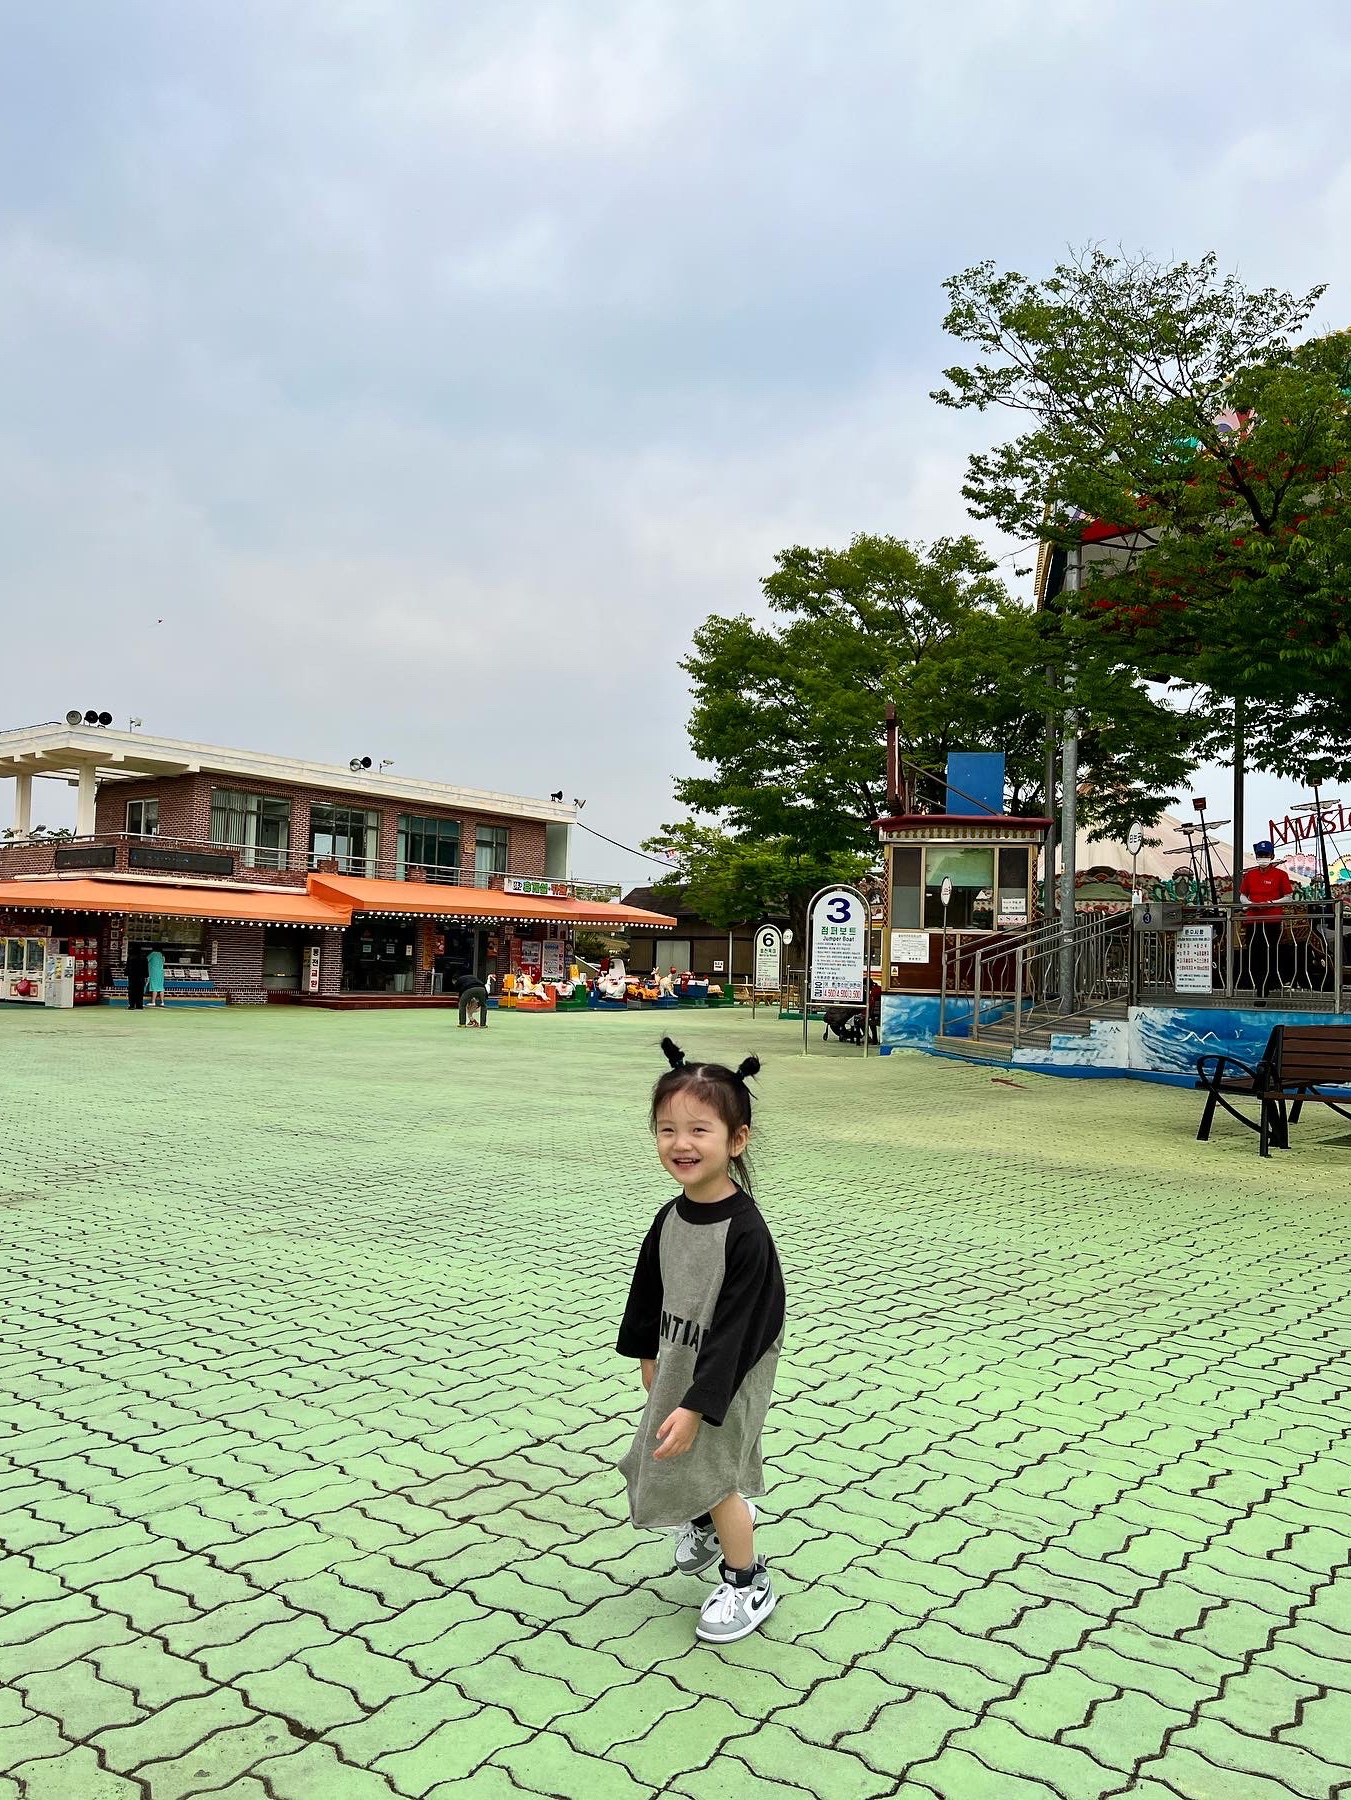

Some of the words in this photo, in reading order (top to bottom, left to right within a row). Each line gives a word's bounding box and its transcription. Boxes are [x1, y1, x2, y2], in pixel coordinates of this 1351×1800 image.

[1269, 804, 1351, 845] Musi
[826, 897, 851, 924] 3
[763, 932, 774, 947] 6
[821, 926, 856, 935] 점퍼보트
[661, 1310, 709, 1353] NTIA
